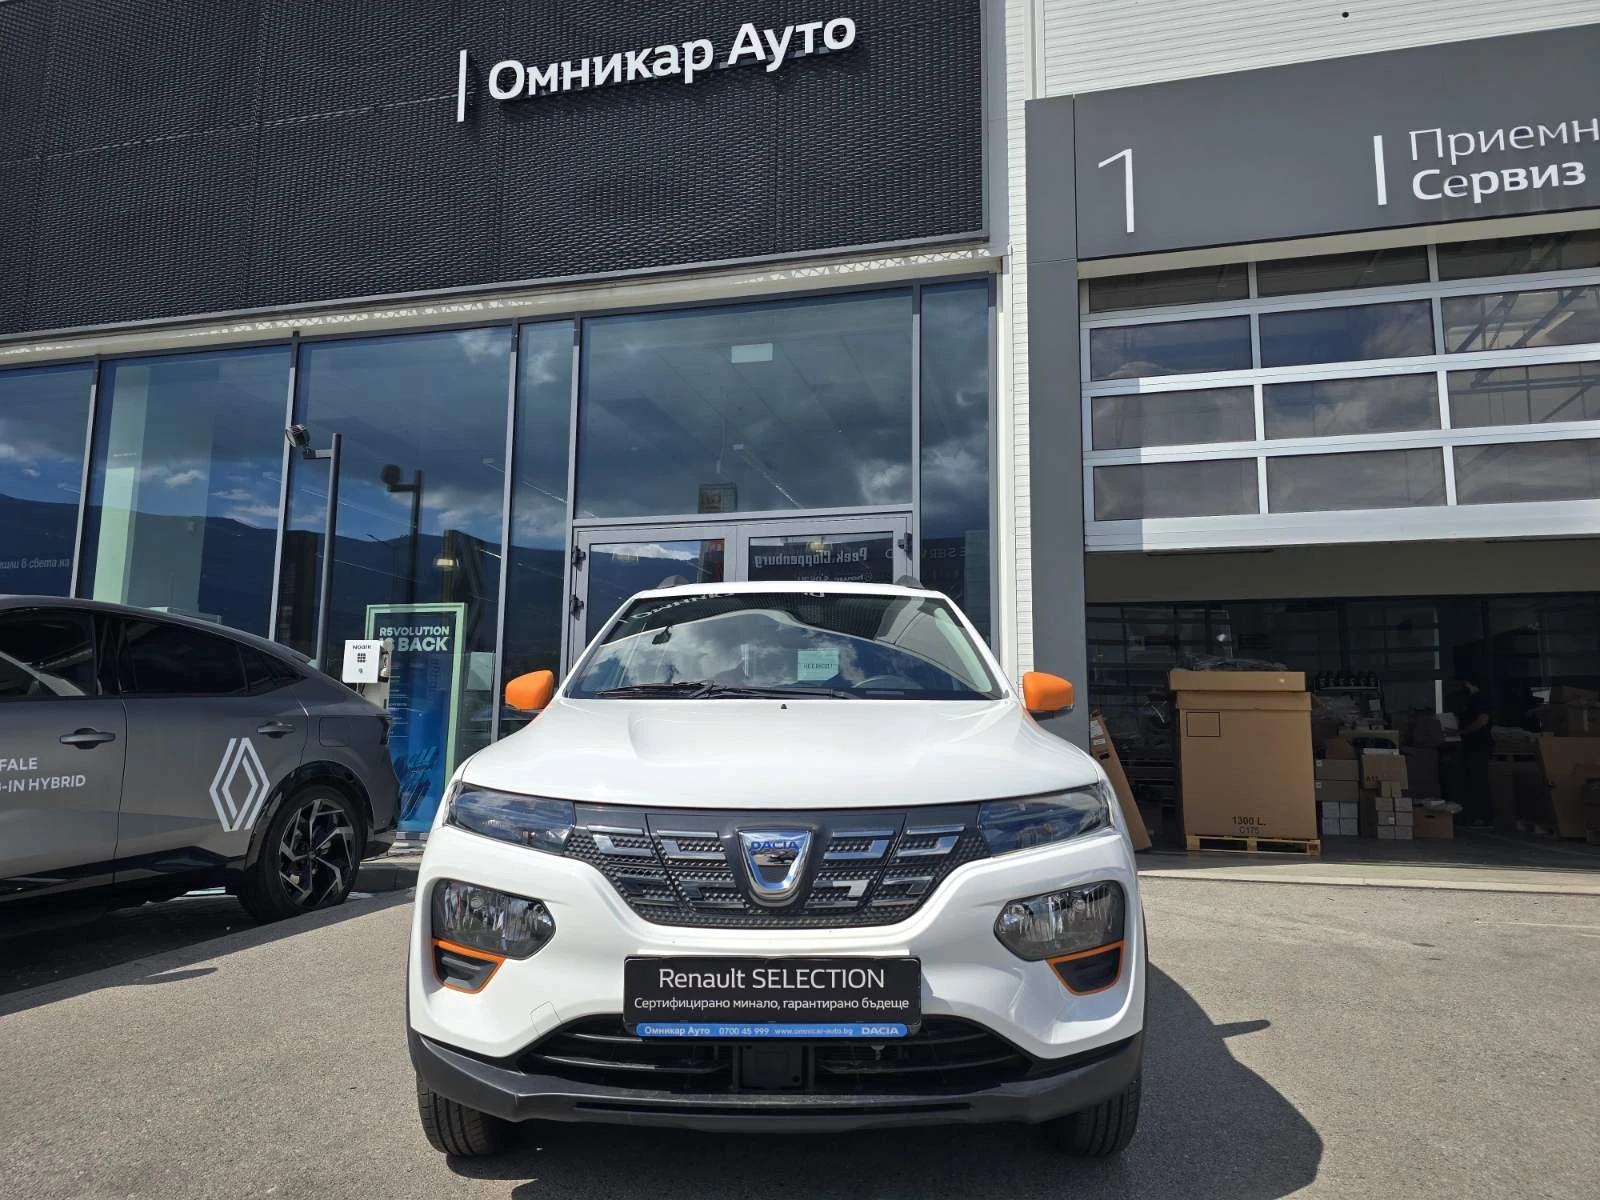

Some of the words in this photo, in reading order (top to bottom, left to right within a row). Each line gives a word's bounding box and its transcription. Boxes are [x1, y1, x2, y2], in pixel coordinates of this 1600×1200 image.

[488, 37, 714, 100] Омникар
[727, 17, 856, 72] Ауто
[1409, 118, 1600, 166] Приемн
[1098, 148, 1135, 233] 1
[1412, 161, 1586, 204] Сервиз
[379, 626, 450, 637] R5VOLUTION
[397, 637, 448, 651] BACK
[28, 774, 87, 791] HYBRID
[1232, 816, 1254, 825] 1300
[751, 841, 800, 850] DACIA
[659, 968, 746, 989] Renault
[752, 968, 885, 989] SELECTION
[634, 996, 731, 1011] Сертифицирано
[733, 999, 781, 1011] минало,
[783, 999, 859, 1011] гарантирано
[861, 996, 910, 1011] бъдеще
[644, 1025, 685, 1036] Омникар
[687, 1026, 711, 1036] Ауто
[719, 1027, 740, 1036] 0700
[741, 1027, 752, 1036] 45
[754, 1027, 770, 1036] 999
[861, 1026, 899, 1035] DACIA
